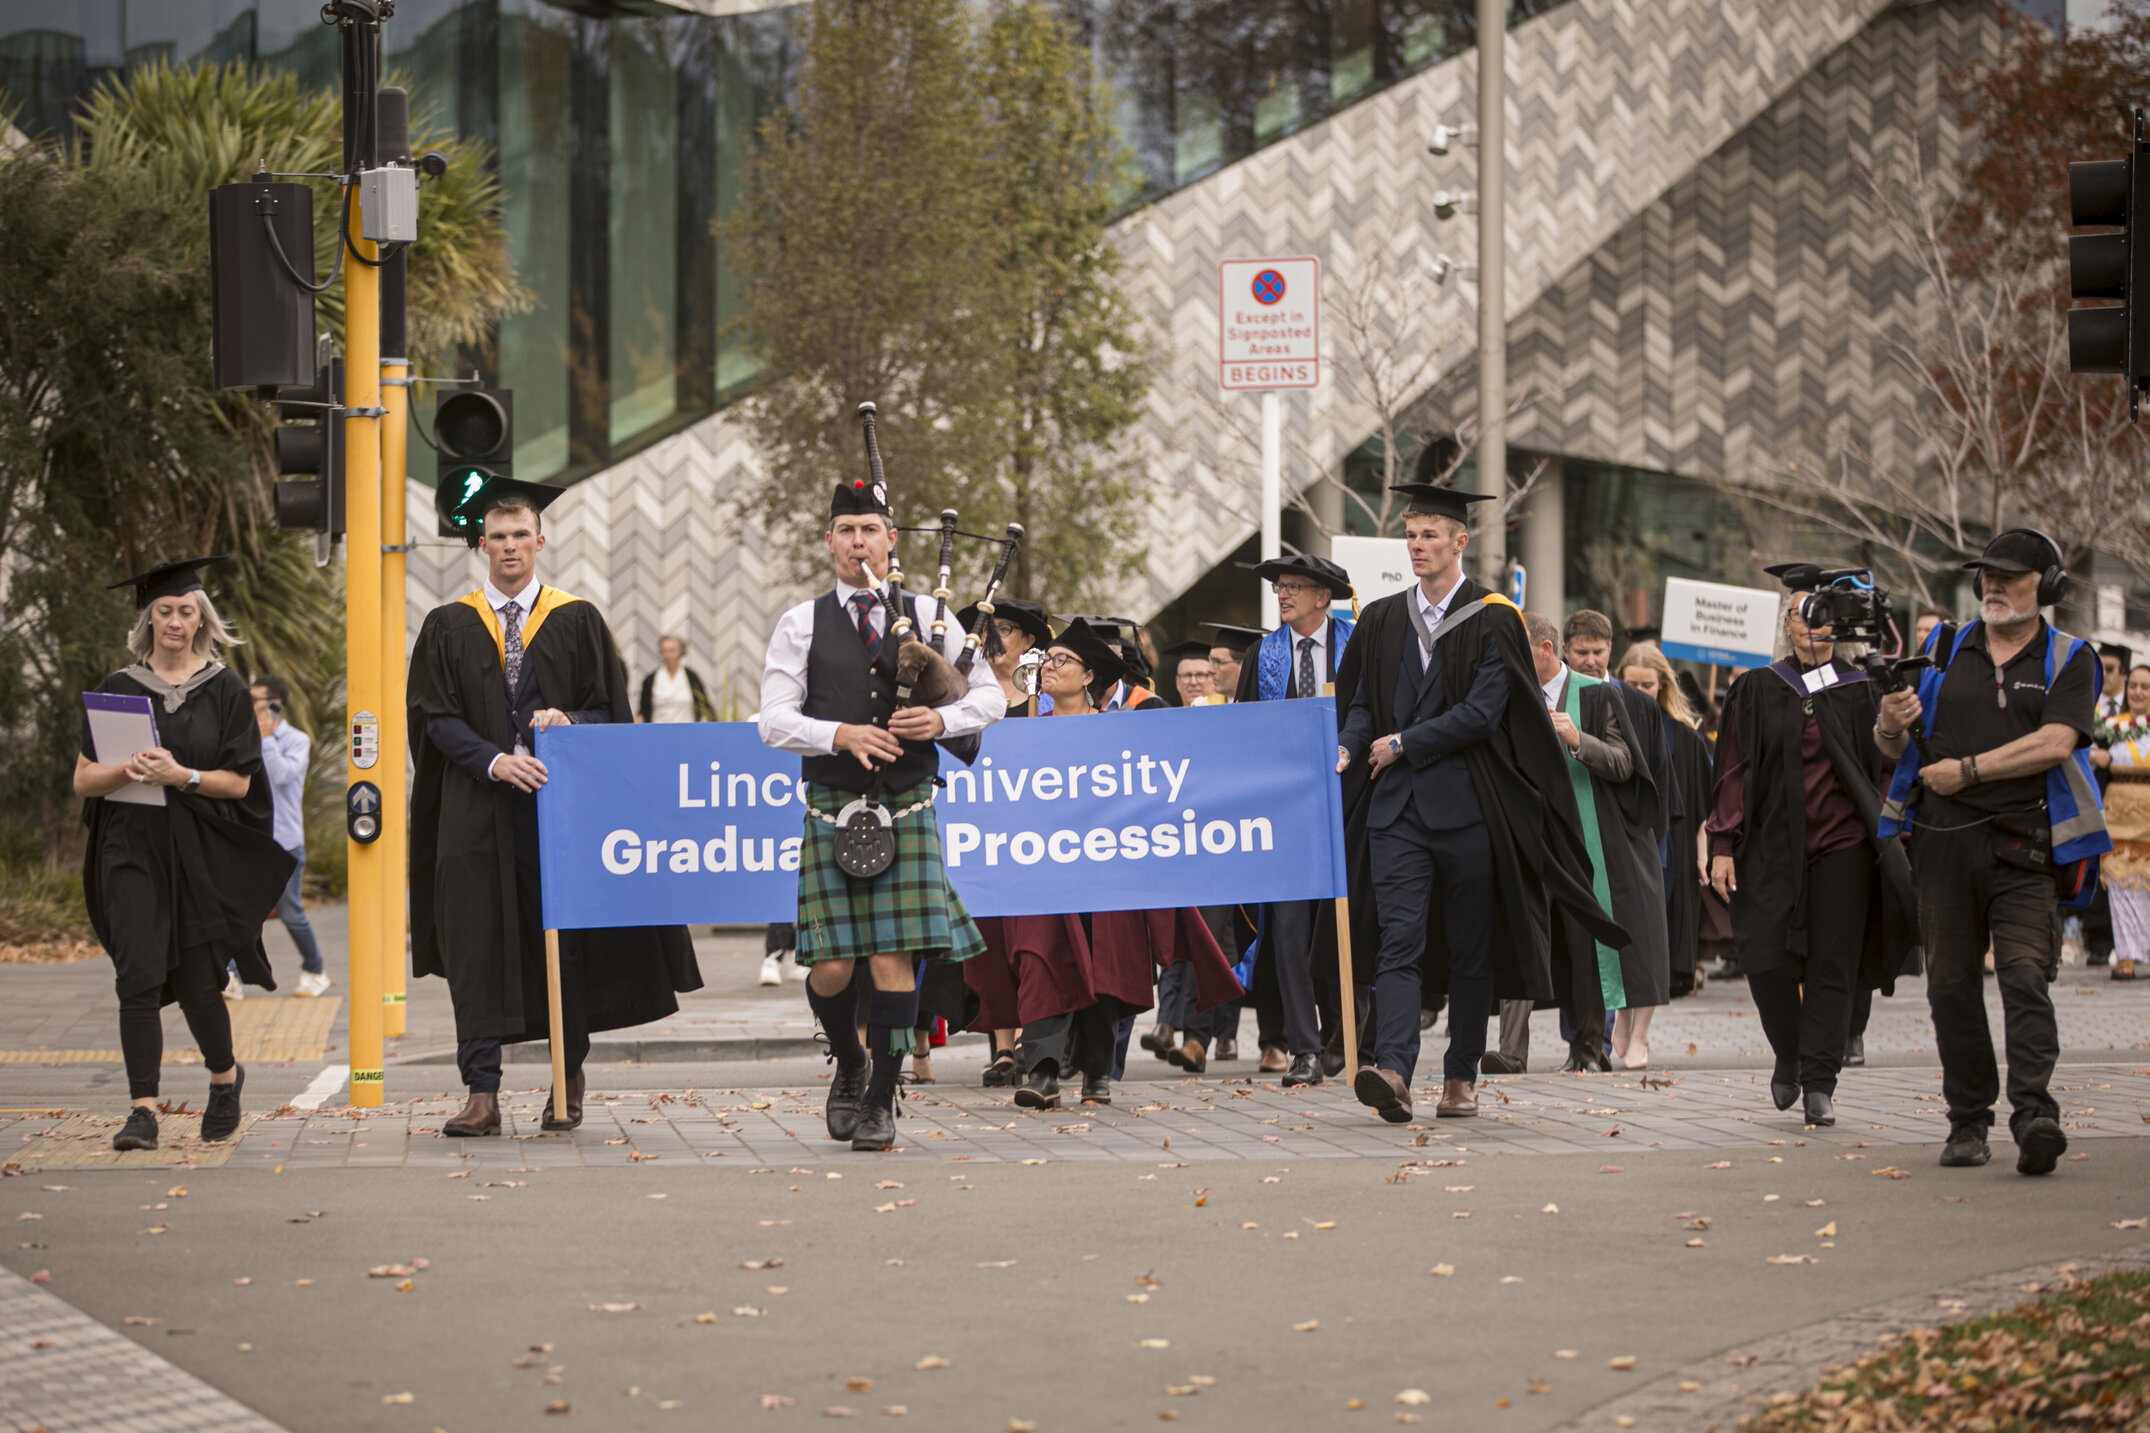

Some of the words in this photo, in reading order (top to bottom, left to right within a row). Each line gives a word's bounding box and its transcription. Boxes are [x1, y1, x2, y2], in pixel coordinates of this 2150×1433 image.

[1236, 311, 1286, 324] Except
[1290, 311, 1304, 320] in
[1228, 327, 1312, 340] Signposted
[1249, 343, 1290, 354] Areas
[1231, 366, 1308, 382] BEGINS
[1382, 572, 1402, 582] PhD
[1696, 597, 1732, 610] Master
[1736, 603, 1748, 612] of
[1696, 611, 1744, 626] Business
[1704, 625, 1747, 640] Finance
[931, 750, 1190, 804] niversity
[601, 825, 803, 875] Gradua
[946, 809, 1274, 868] Procession
[355, 1072, 384, 1080] DANGE
